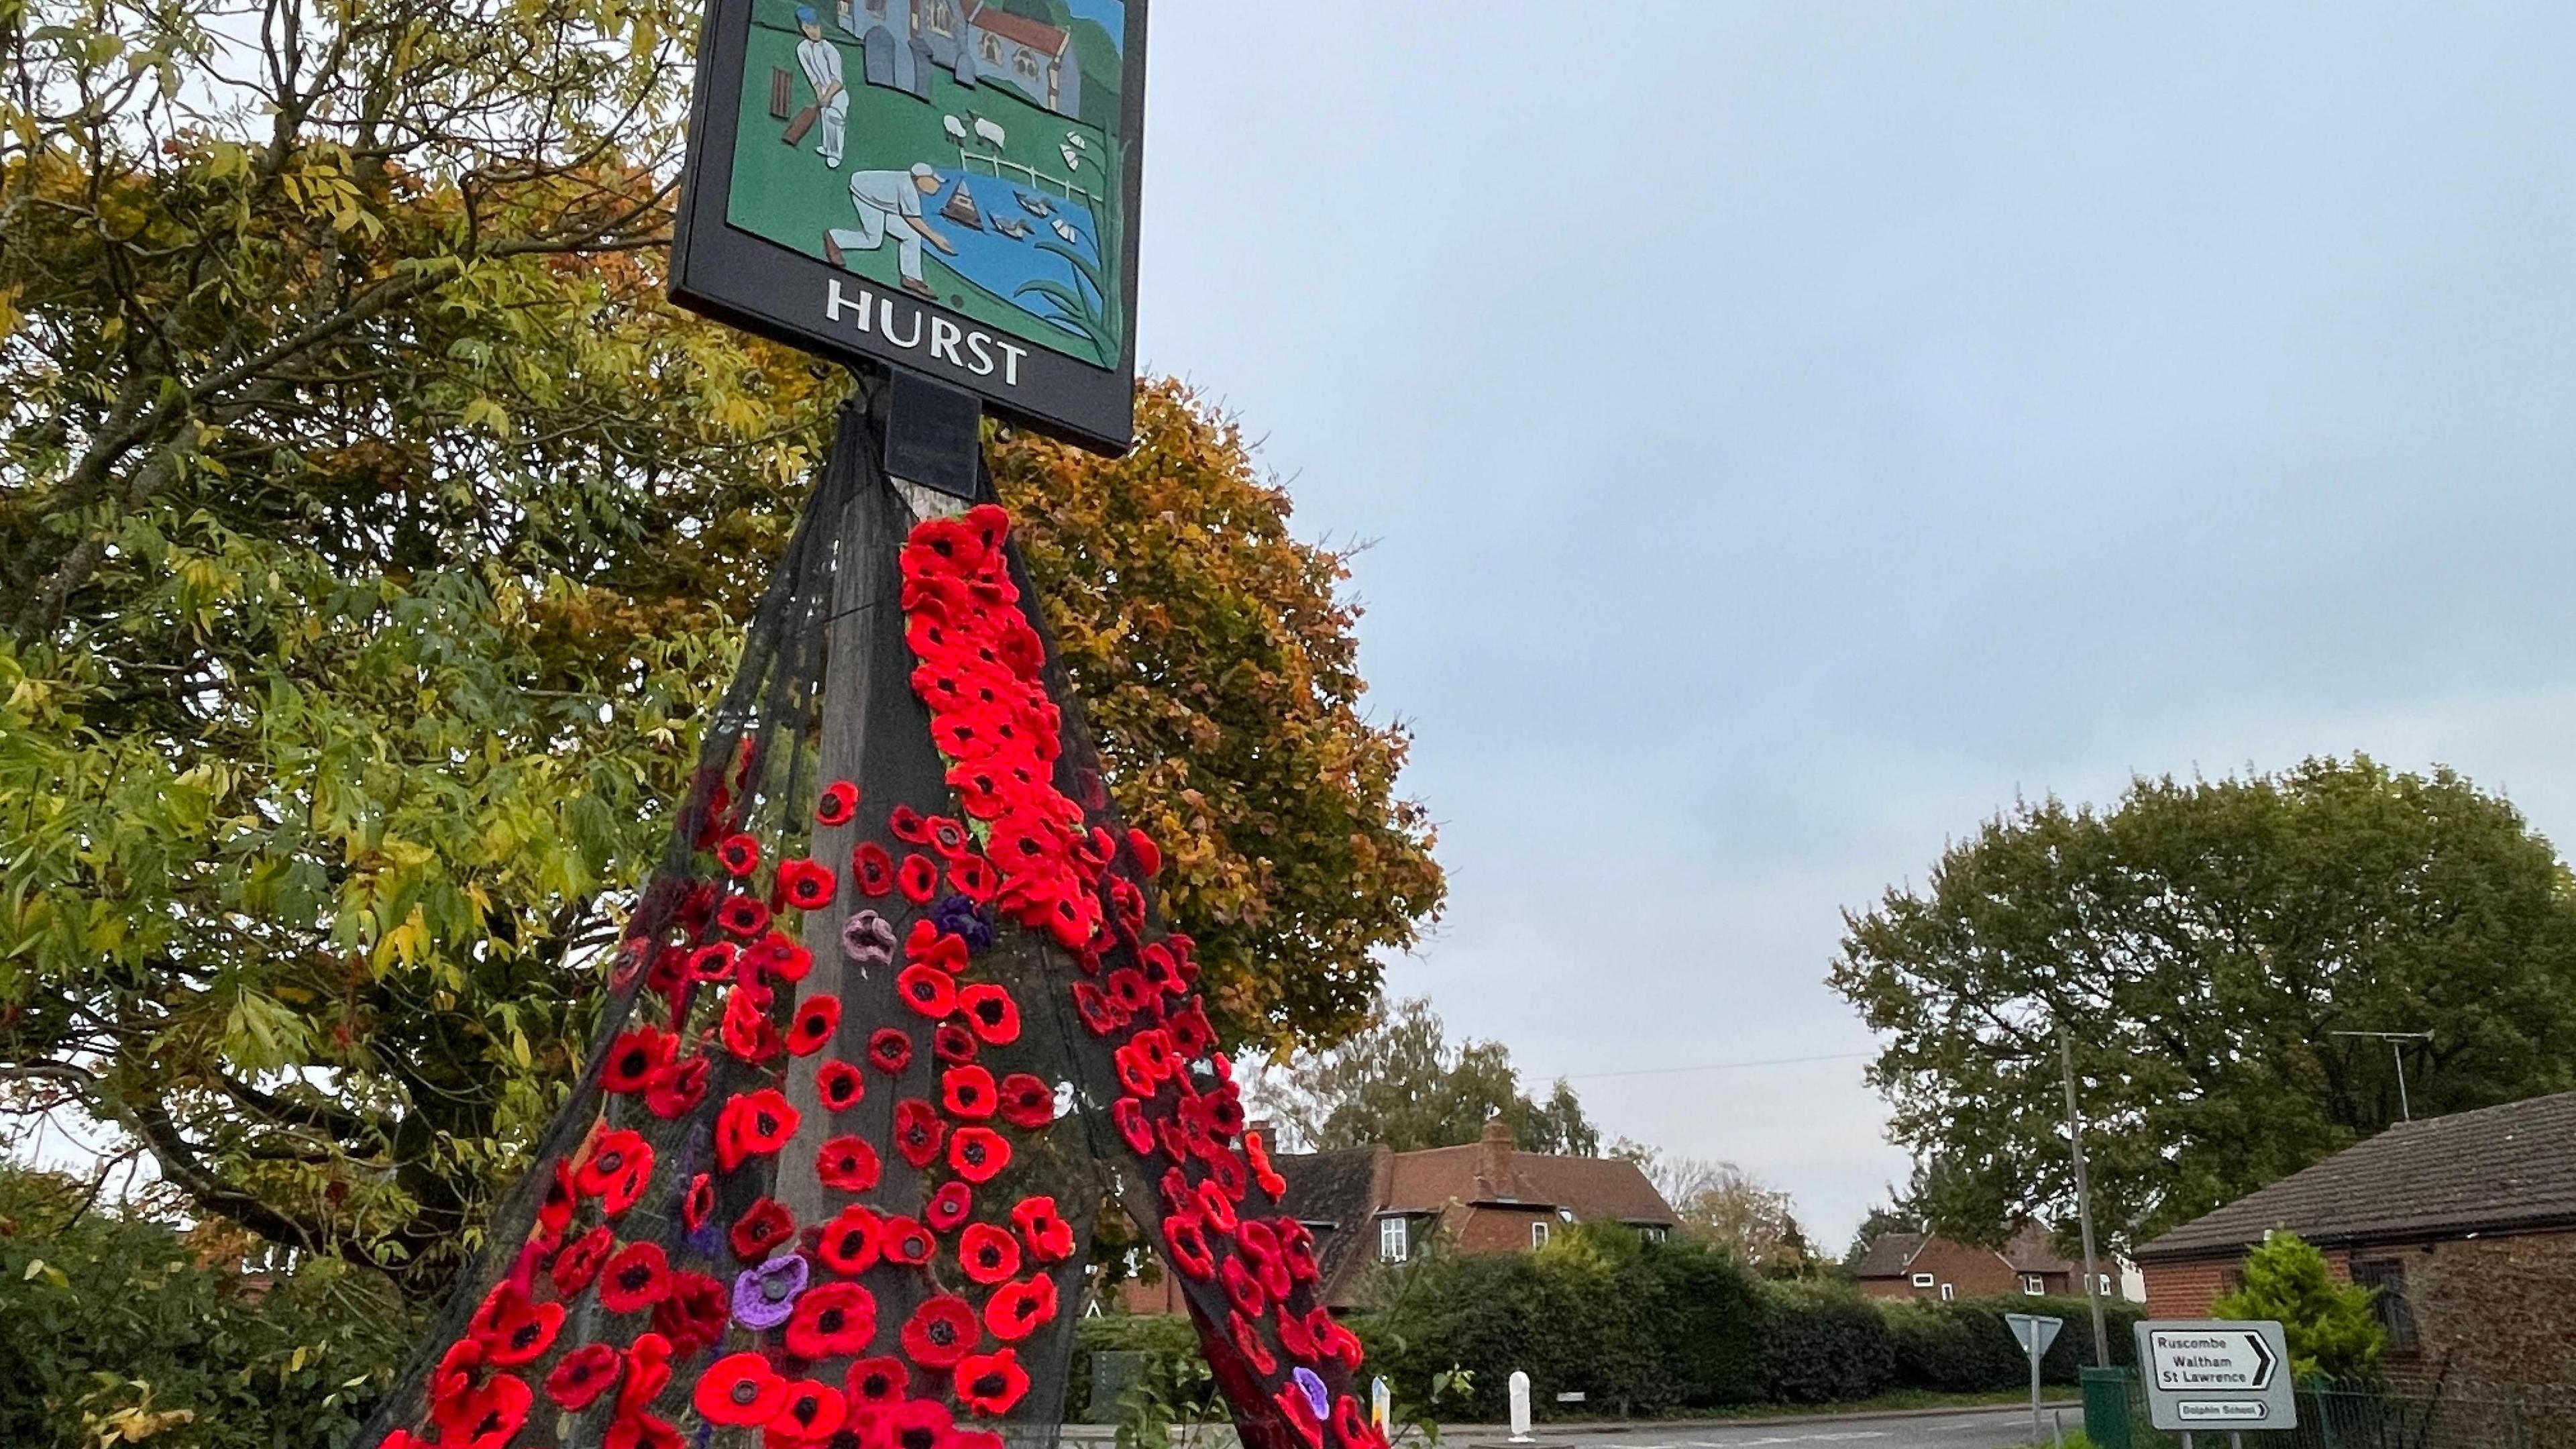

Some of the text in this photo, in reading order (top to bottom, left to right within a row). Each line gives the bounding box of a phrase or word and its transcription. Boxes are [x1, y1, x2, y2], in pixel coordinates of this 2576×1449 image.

[826, 278, 1028, 386] HURST
[2158, 1337, 2226, 1349] Ruscombe
[2173, 1356, 2232, 1368] Waltham
[2163, 1371, 2247, 1383] St Lawrence
